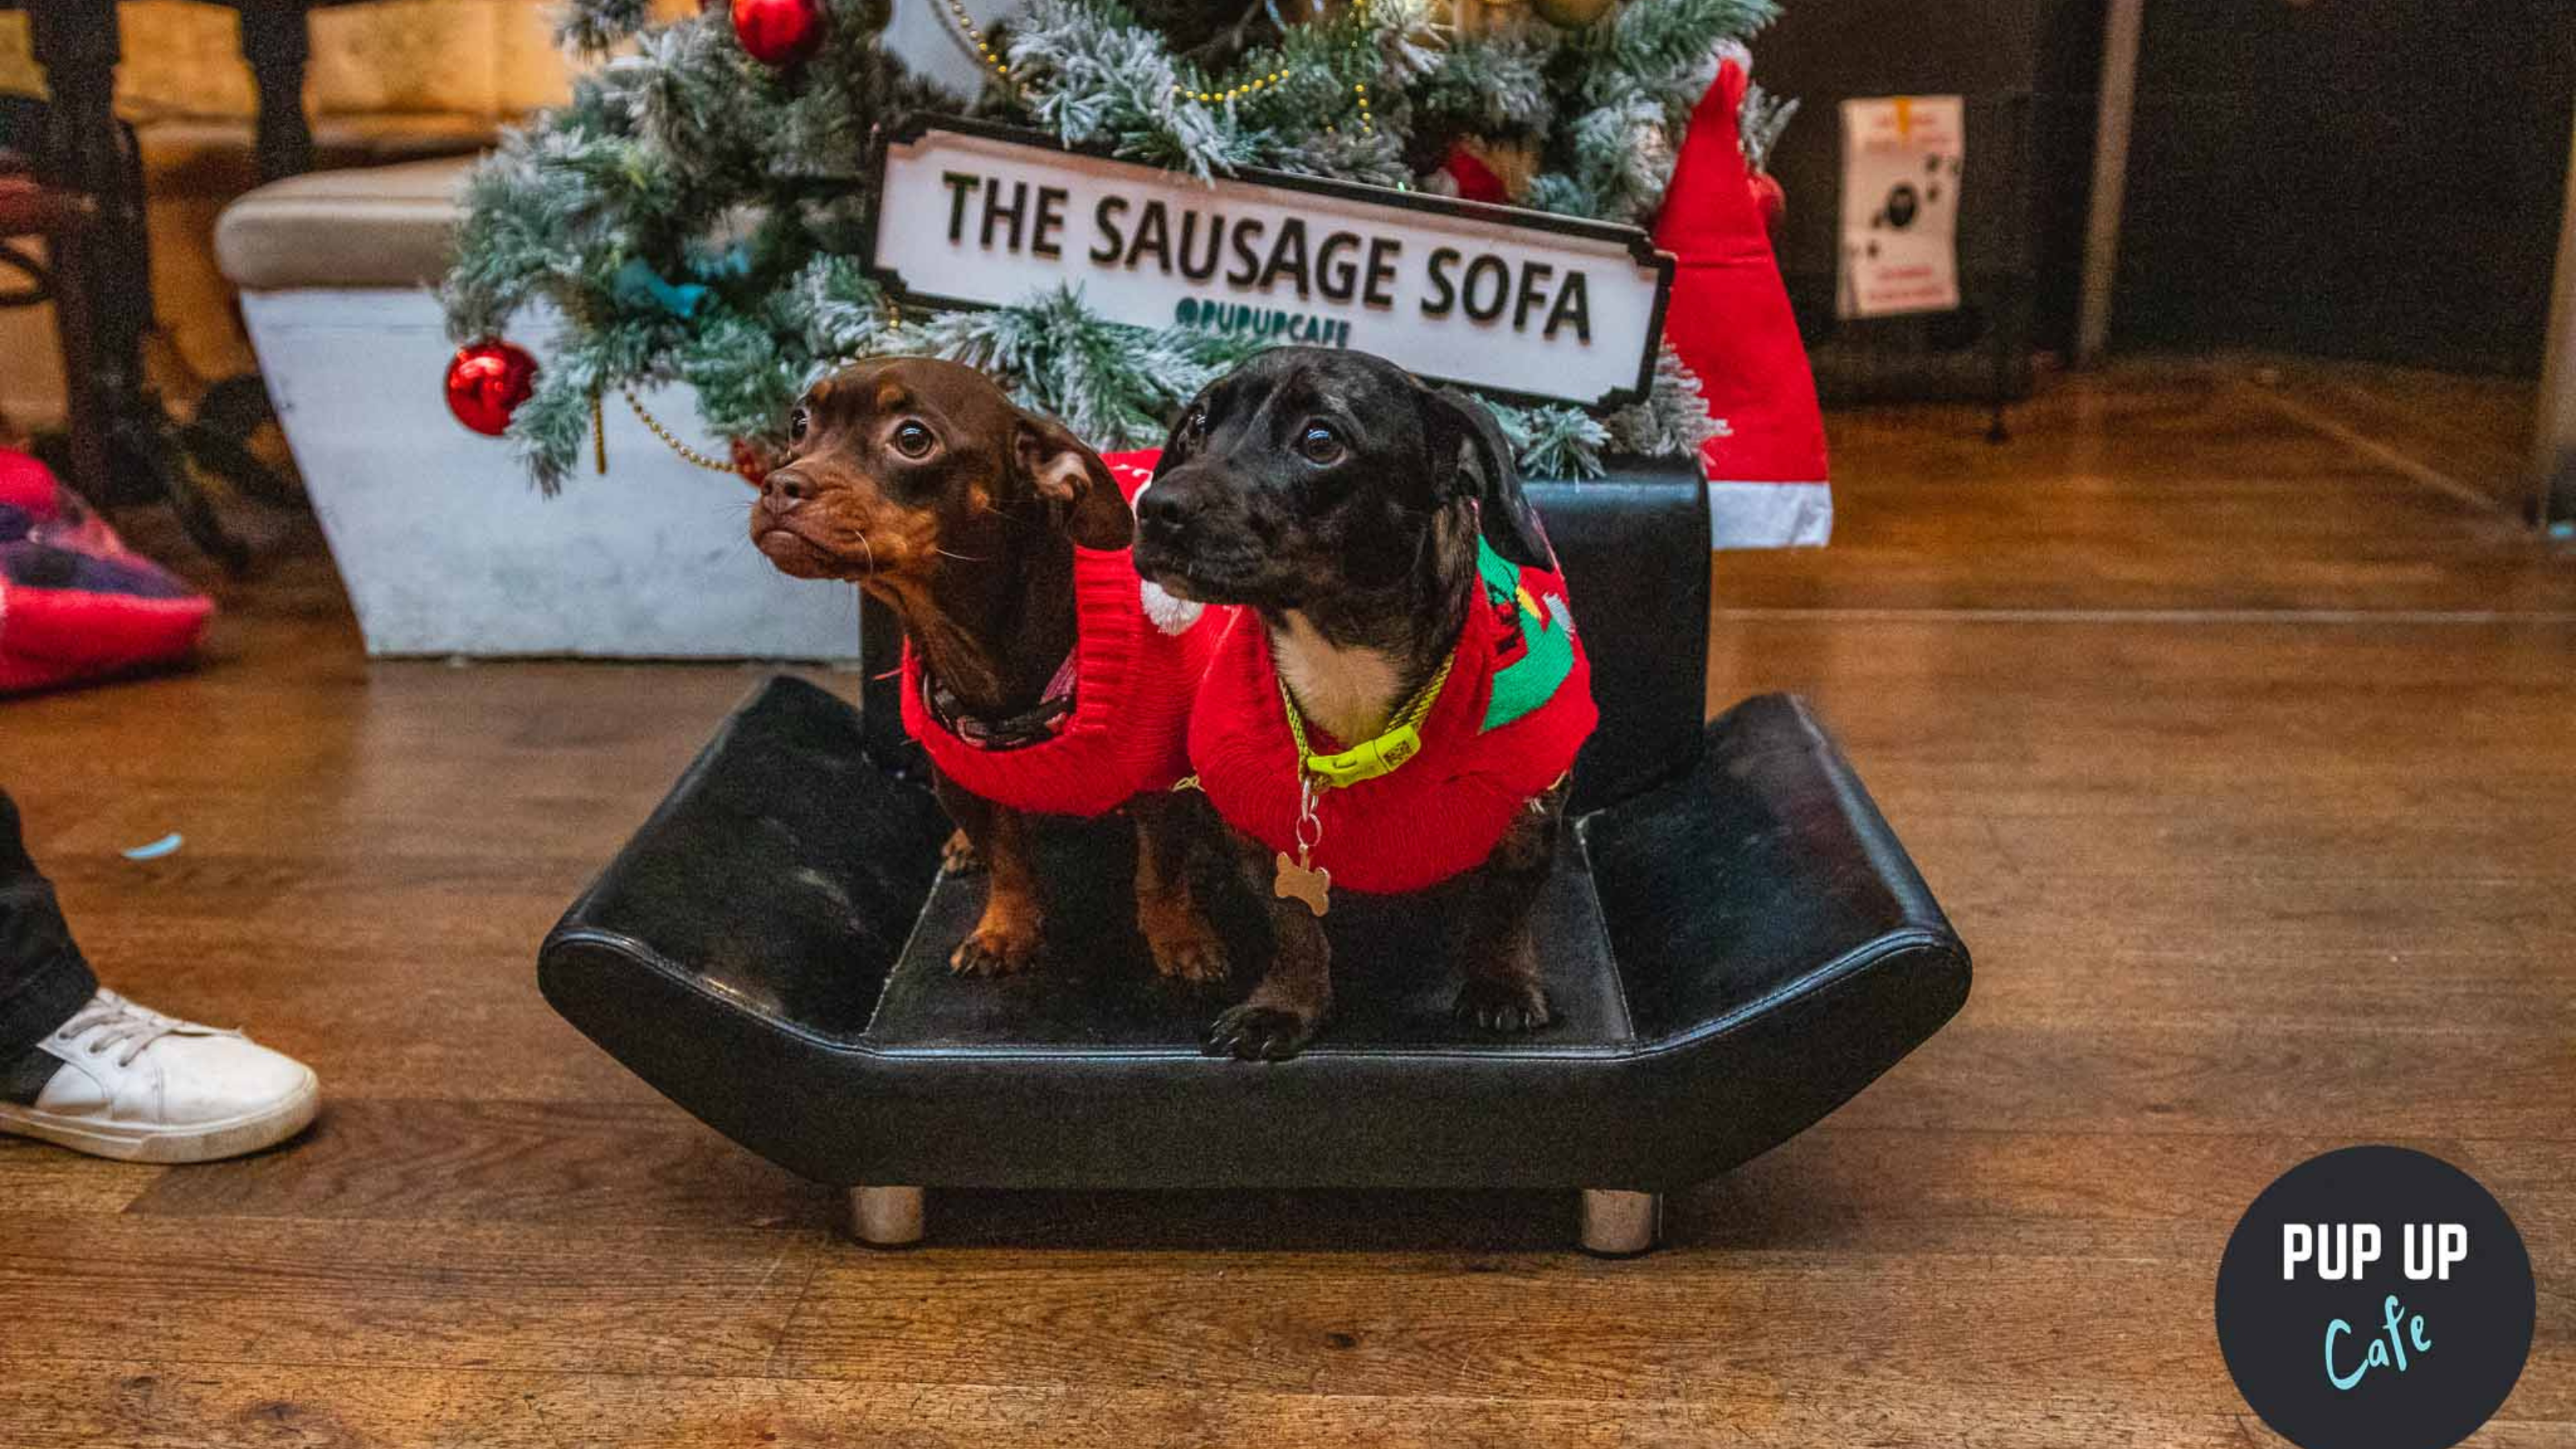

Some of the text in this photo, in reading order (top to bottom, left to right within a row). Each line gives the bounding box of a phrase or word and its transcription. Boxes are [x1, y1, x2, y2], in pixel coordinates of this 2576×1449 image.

[942, 171, 1592, 343] THE SAUSAGE SOFA
[1175, 296, 1352, 348] @PUPUPCAFE
